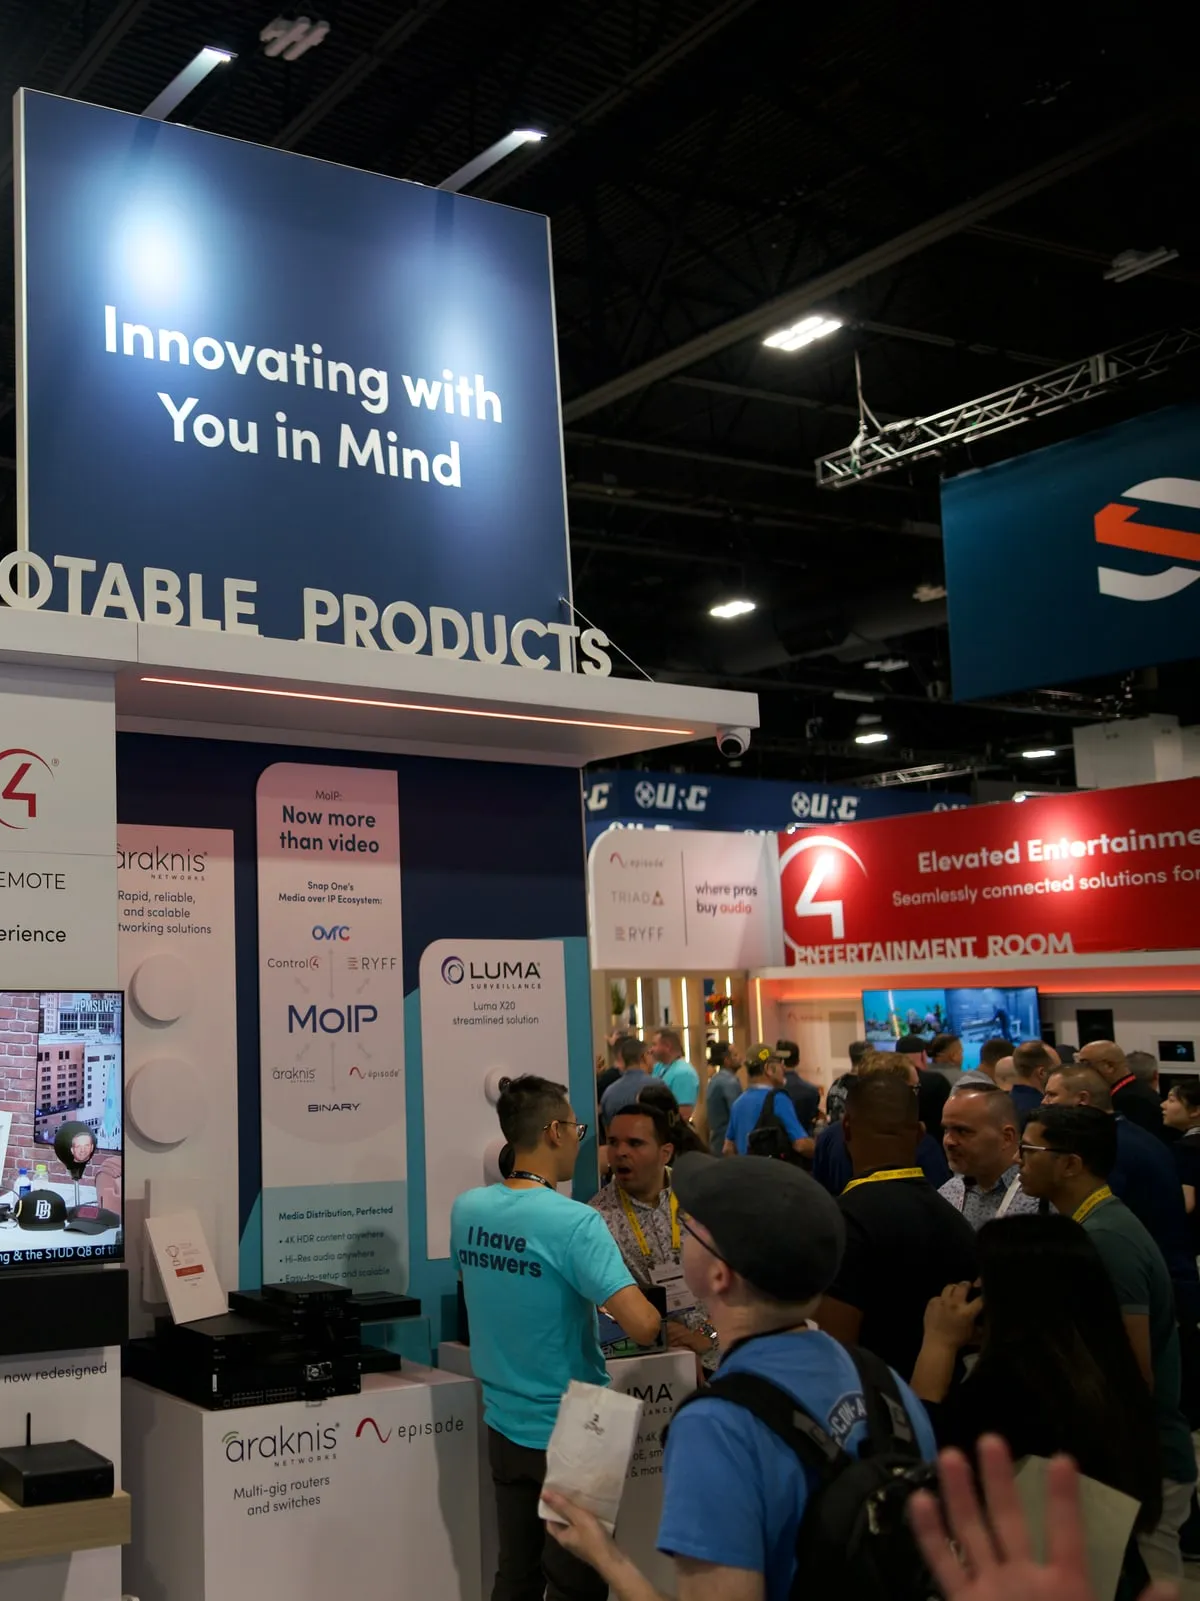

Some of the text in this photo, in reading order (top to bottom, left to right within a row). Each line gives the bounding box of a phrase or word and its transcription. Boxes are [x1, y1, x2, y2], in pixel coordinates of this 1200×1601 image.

[104, 305, 503, 423] Innovating with
[157, 392, 462, 488] You in Mind
[303, 588, 613, 677] PRODUCTS
[282, 805, 376, 827] Now more
[280, 830, 380, 853] than video
[917, 842, 1020, 874] Elevated
[307, 881, 354, 892] Snap One's
[695, 881, 758, 898] where pros
[892, 884, 978, 907] Seamlessly
[982, 875, 1075, 900] connected
[1079, 872, 1167, 890] solutions
[118, 890, 196, 904] Rapid, reliable,
[278, 893, 306, 903] Media
[327, 895, 336, 903] IP
[337, 895, 383, 906] Ecosystem:
[611, 890, 650, 905] TRIAD
[123, 907, 191, 918] and scalable
[696, 901, 752, 917] buy audio
[118, 922, 212, 935] tworking solutions
[628, 926, 665, 942] RYFF
[796, 932, 1075, 965] ENTERTAINMENT ROOM
[362, 957, 397, 970] RYFF
[470, 962, 541, 979] LUMA
[473, 1001, 516, 1011] Luma X20
[288, 1005, 378, 1033] MoIP
[452, 1015, 539, 1025] streamlined solution
[308, 1103, 360, 1113] BINARY
[278, 1205, 393, 1221] Media Distribution, Perfected
[296, 1235, 315, 1243] HDR
[316, 1233, 345, 1242] content
[346, 1231, 384, 1241] anywhere
[468, 1226, 527, 1253] I have
[13, 1250, 23, 1261] &
[25, 1248, 42, 1260] the
[45, 1246, 73, 1259] STUD
[76, 1245, 92, 1259] QB
[94, 1245, 107, 1257] of
[313, 1252, 335, 1262] audio
[459, 1249, 542, 1278] answers
[342, 1269, 357, 1278] and
[4, 1373, 33, 1384] now
[35, 1362, 108, 1381] redesigned
[626, 1384, 674, 1404] MA
[397, 1416, 465, 1443] episode
[222, 1422, 338, 1463] araknis
[274, 1453, 338, 1468] NETWORKS
[233, 1475, 331, 1500] Multi-gig routers
[247, 1495, 321, 1516] and switches
